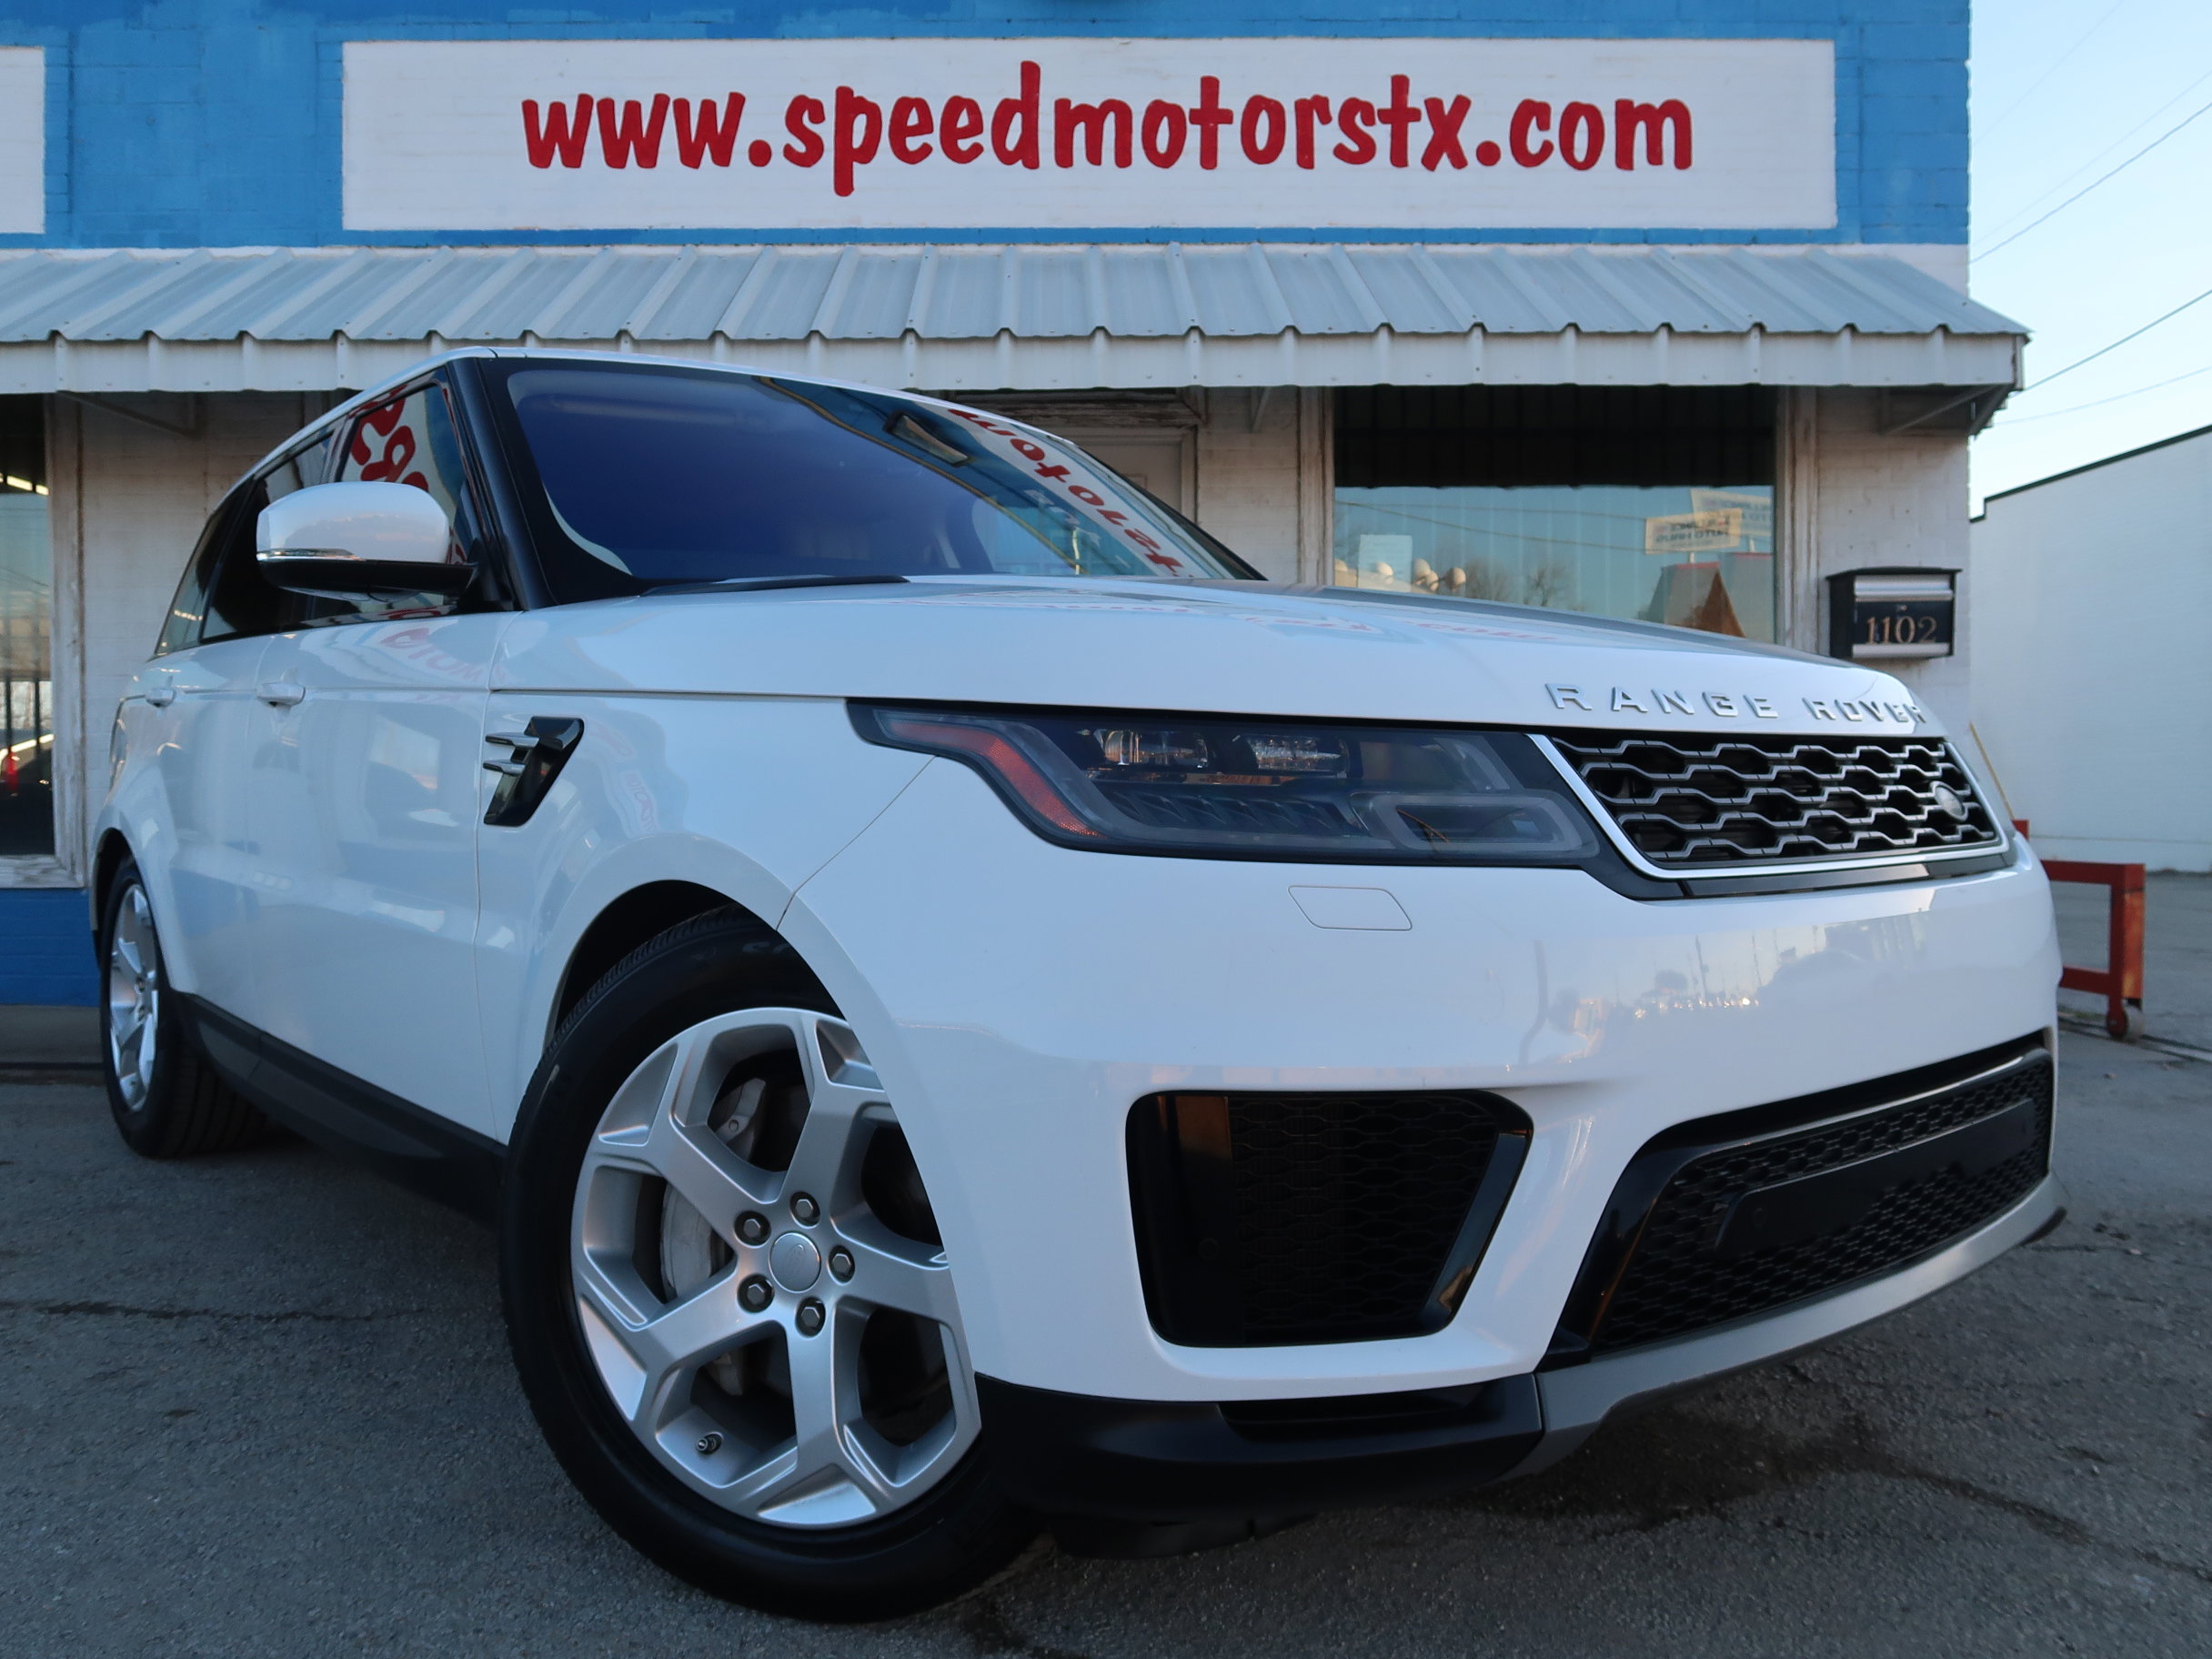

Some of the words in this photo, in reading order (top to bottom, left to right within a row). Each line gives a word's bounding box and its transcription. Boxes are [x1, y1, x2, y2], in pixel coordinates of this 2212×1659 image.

[523, 61, 1693, 197] www.speedmotorstx.com
[1865, 615, 1937, 645] 1102
[1545, 683, 1779, 719] RANGE
[1801, 697, 1926, 724] ROVER
